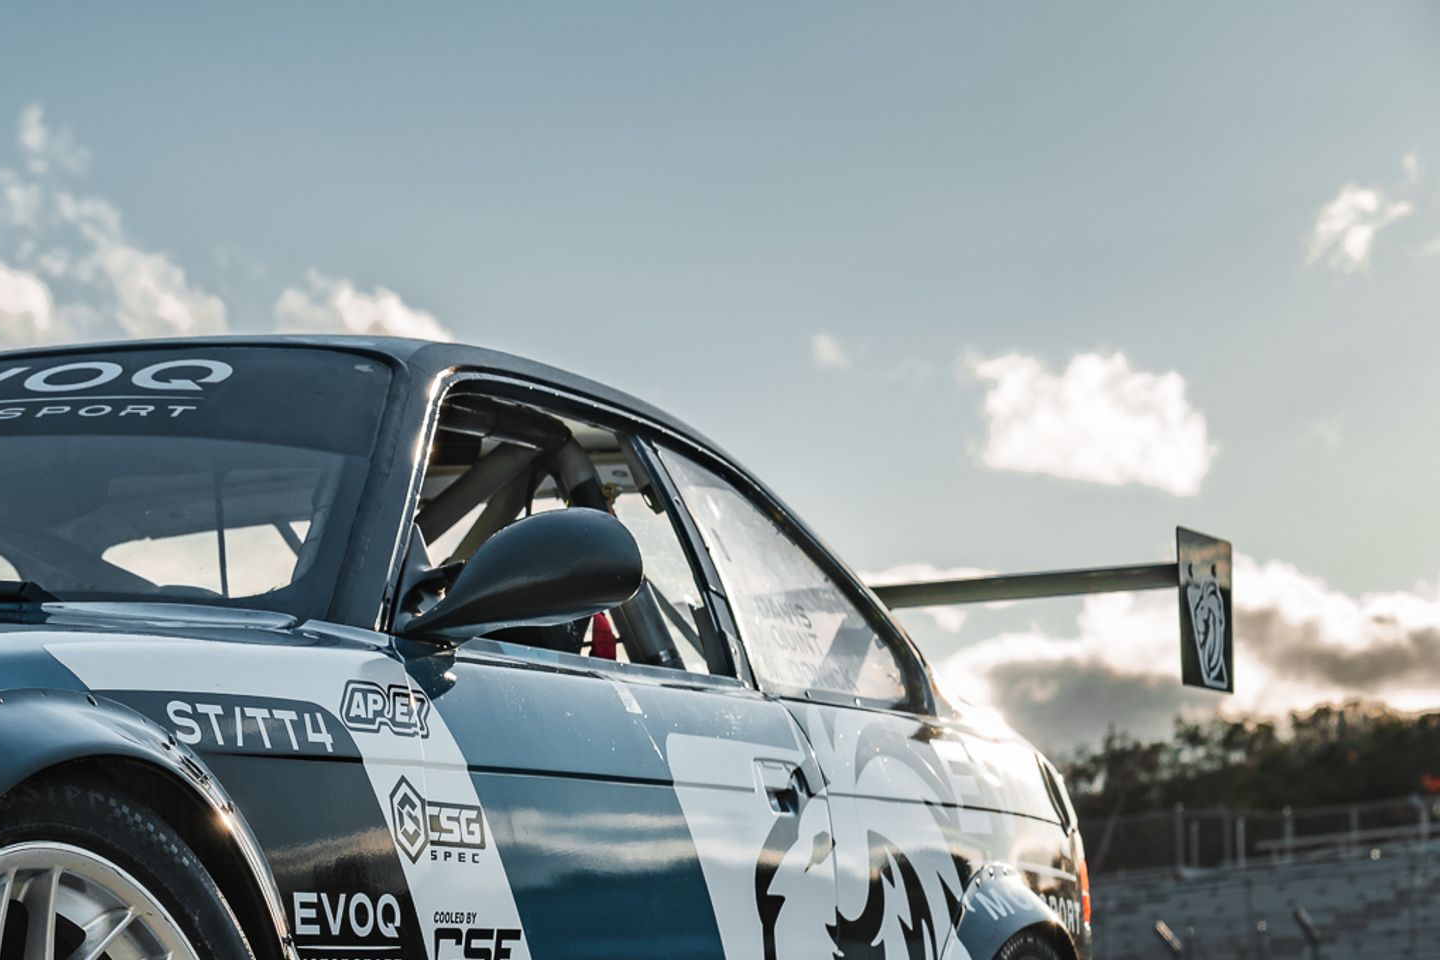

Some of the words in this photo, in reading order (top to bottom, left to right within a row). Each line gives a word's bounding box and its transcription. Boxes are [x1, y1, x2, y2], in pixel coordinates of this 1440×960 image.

[431, 849, 481, 864] SPEC
[293, 891, 401, 939] EVOQ
[433, 911, 465, 925] COOLED
[466, 911, 478, 925] BY
